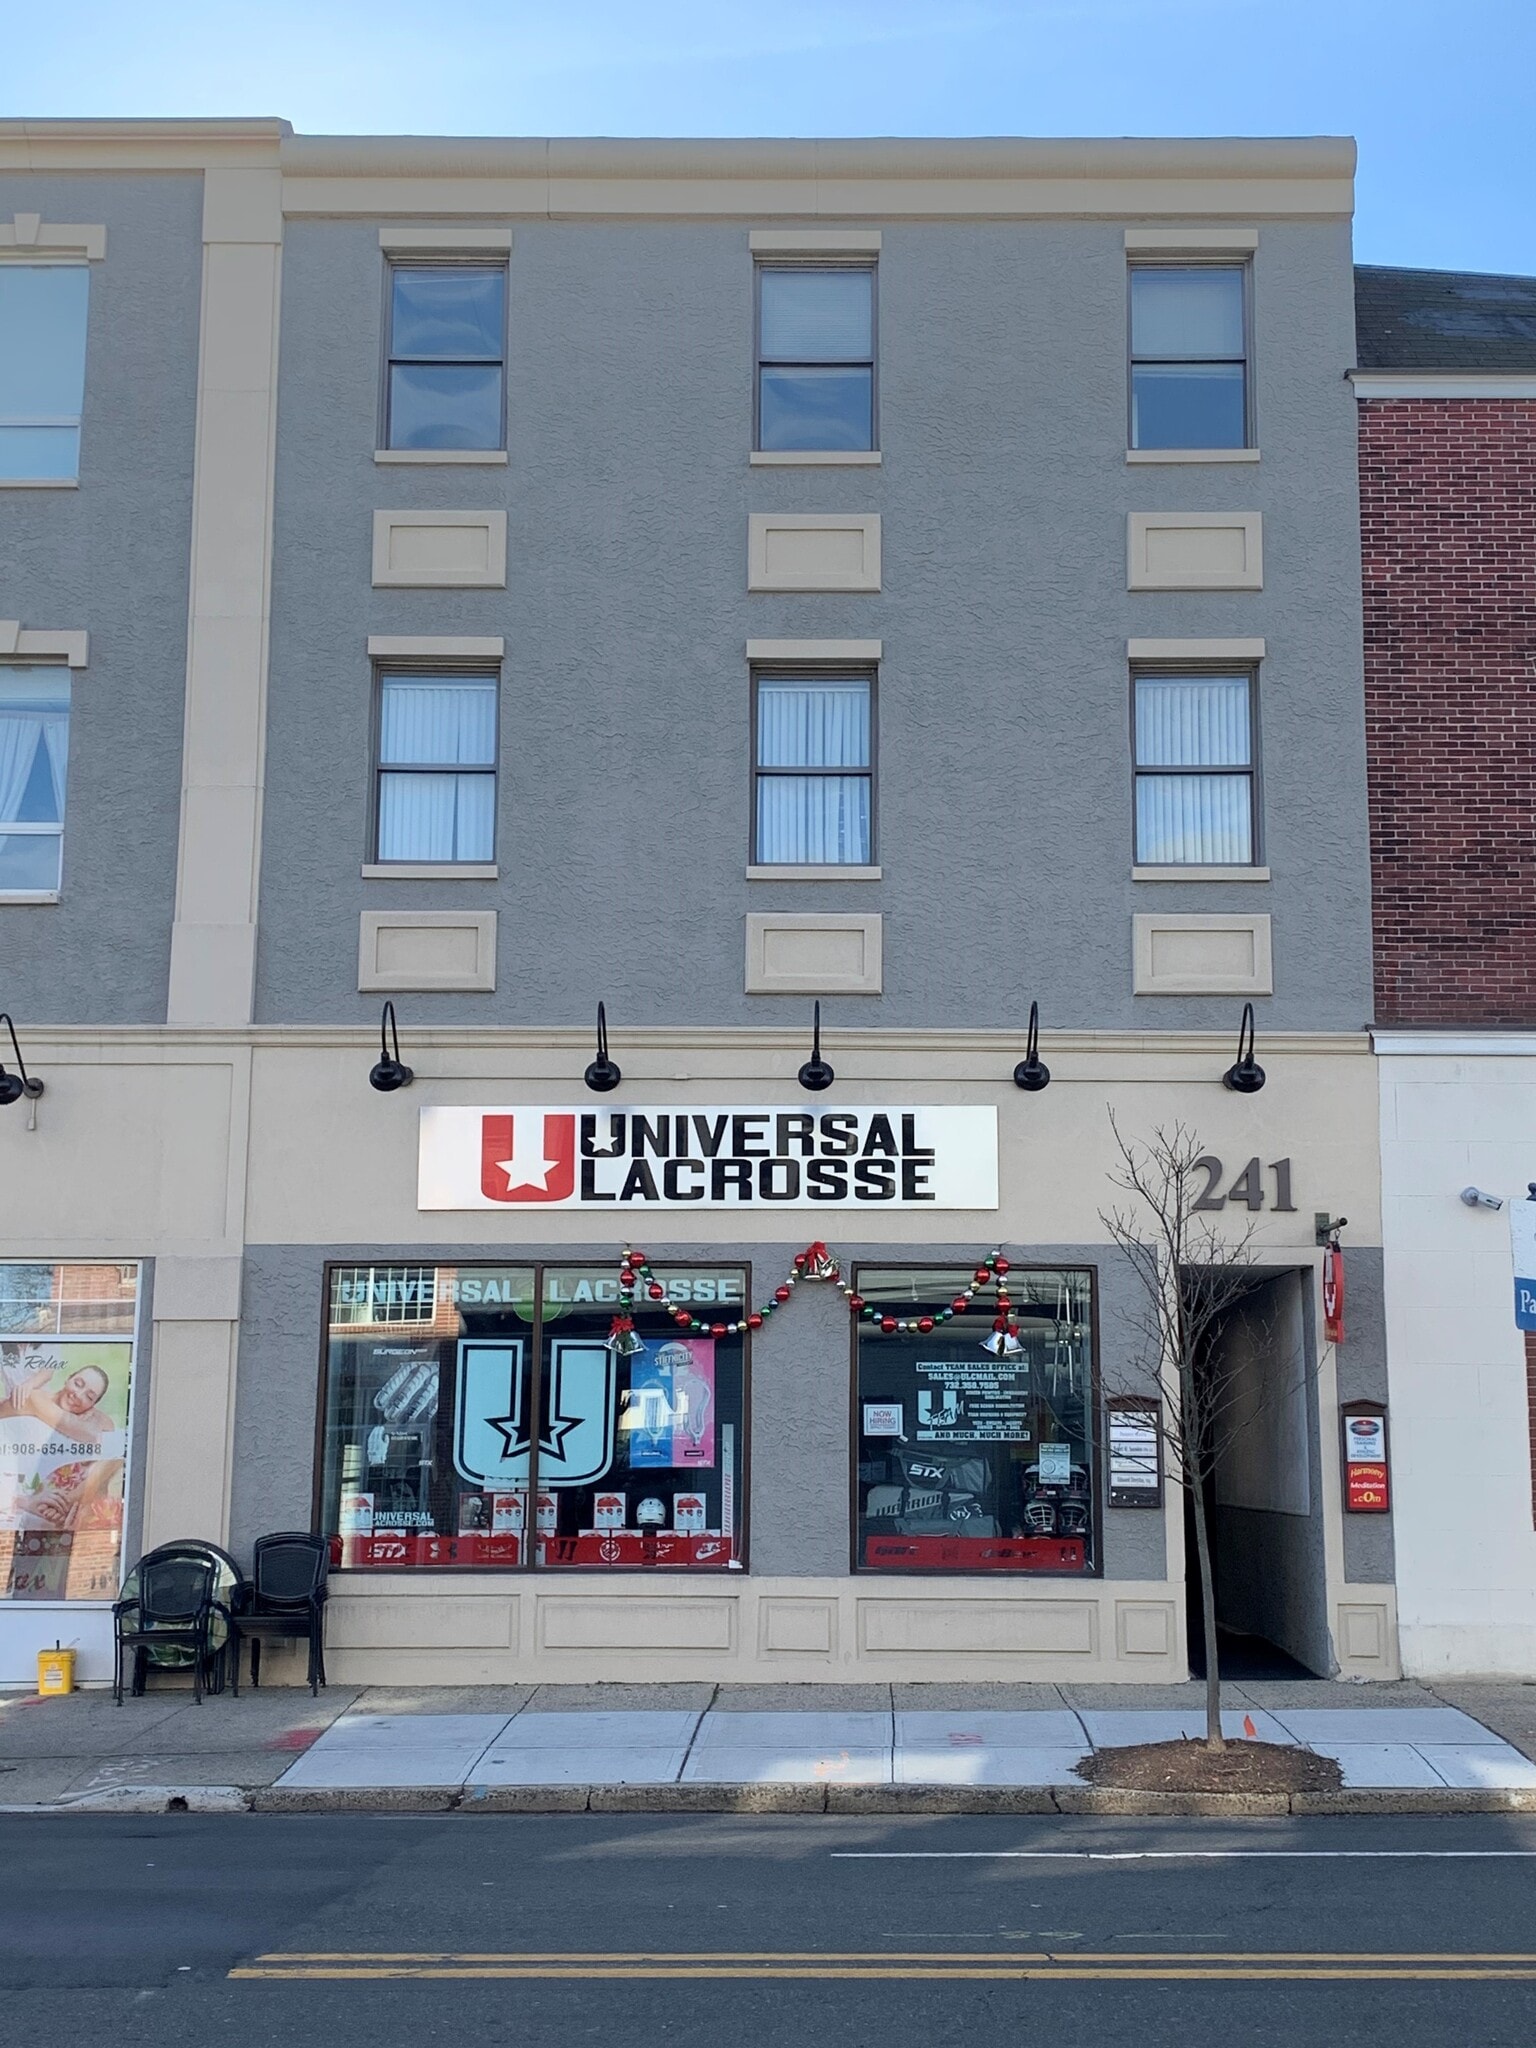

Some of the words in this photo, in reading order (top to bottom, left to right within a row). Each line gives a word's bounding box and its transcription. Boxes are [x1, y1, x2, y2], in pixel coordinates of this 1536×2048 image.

[580, 1113, 935, 1157] UNIVERSAL
[580, 1159, 936, 1201] LACROSSE
[1191, 1155, 1298, 1212] 241
[341, 1279, 522, 1303] UNIVERSAL
[24, 1355, 68, 1369] Relax
[918, 1363, 944, 1371] Contact
[946, 1363, 965, 1371] TEAM
[967, 1363, 989, 1371] SALES
[991, 1363, 1017, 1371] OFFICE
[909, 1463, 945, 1479] STX
[1350, 1467, 1384, 1478] Harmony
